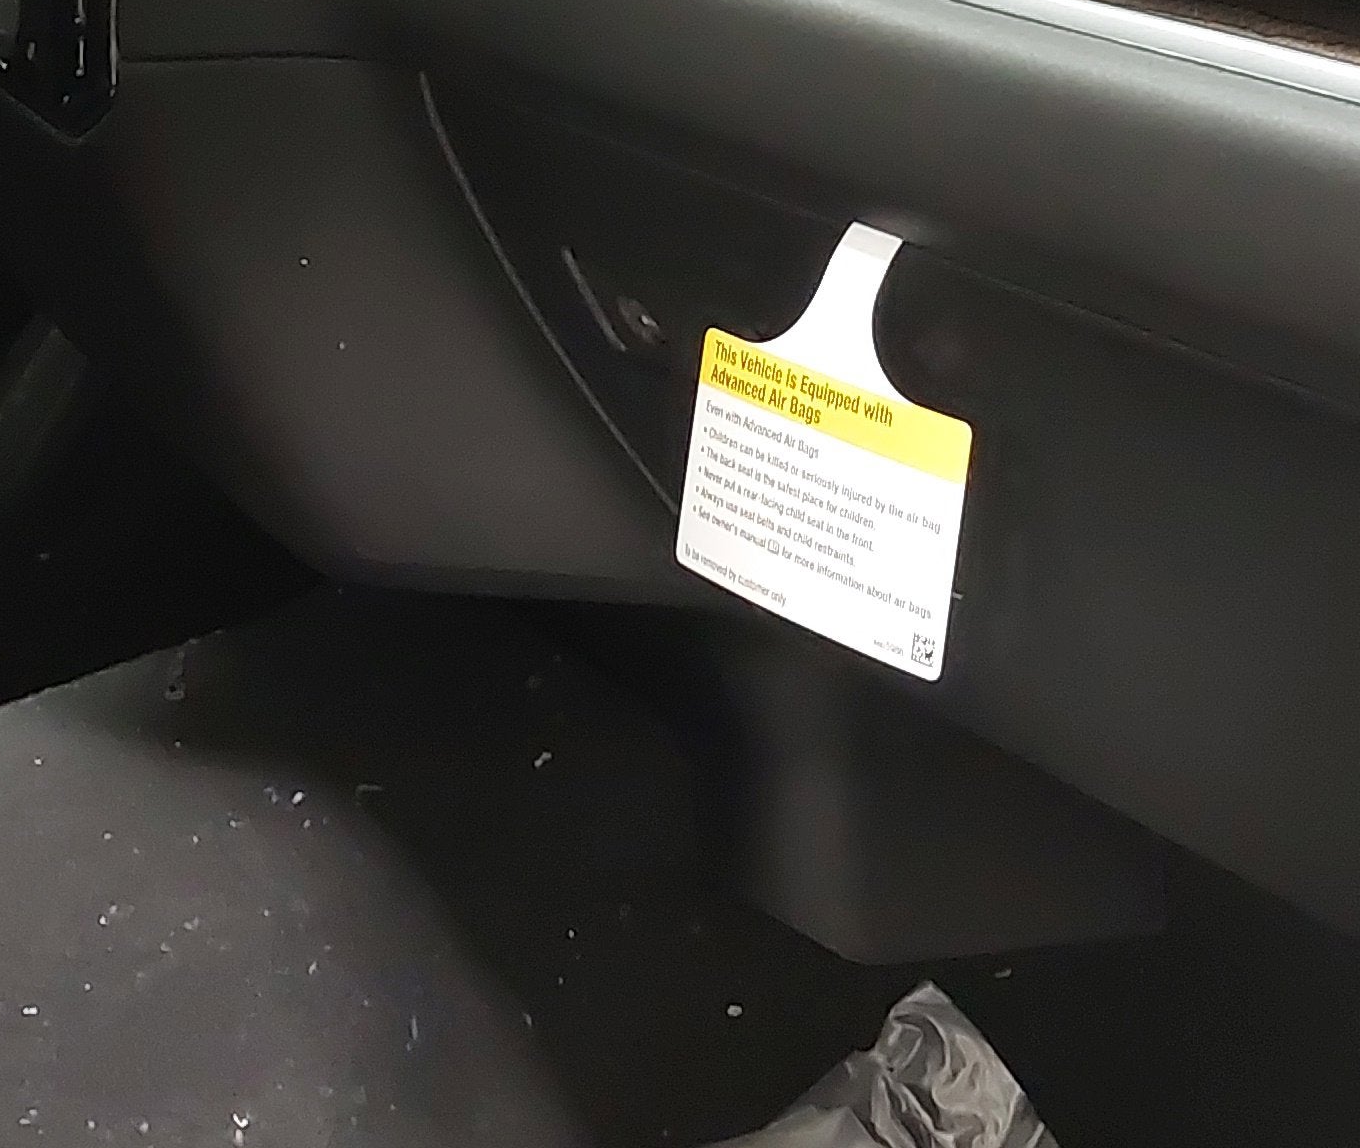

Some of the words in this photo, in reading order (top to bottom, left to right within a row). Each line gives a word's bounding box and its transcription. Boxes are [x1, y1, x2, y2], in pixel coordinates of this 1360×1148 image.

[710, 364, 767, 402] Advanced
[767, 388, 788, 411] Air
[789, 395, 821, 425] Bags
[715, 339, 737, 366] This
[740, 350, 783, 384] Vehicle
[785, 368, 797, 390] is
[800, 375, 860, 414] Equipped
[864, 402, 893, 427] with
[705, 399, 724, 419] Even
[725, 411, 742, 427] with
[742, 416, 783, 444] Advanced
[783, 433, 796, 449] Air
[797, 439, 819, 460] Bags
[700, 485, 724, 508] Always
[725, 501, 739, 515] use
[739, 507, 756, 523] seat
[756, 513, 775, 531] belts
[776, 524, 792, 539] and
[792, 532, 813, 548] child
[703, 465, 723, 485] Never
[723, 478, 736, 493] put
[736, 484, 742, 496] a
[785, 507, 806, 523] child
[806, 515, 825, 532] seat
[825, 522, 834, 535] in
[836, 526, 850, 541] the
[706, 445, 719, 463] The
[719, 453, 736, 469] back
[737, 463, 754, 479] seat
[754, 469, 762, 483] is
[763, 473, 776, 489] the
[777, 480, 801, 499] safest
[801, 491, 824, 509] place
[826, 499, 838, 515] for
[708, 426, 738, 449] Children
[739, 443, 754, 457] can
[755, 447, 765, 462] be
[767, 452, 789, 473] killed
[790, 465, 799, 476] or
[801, 469, 840, 495] seriously
[841, 484, 873, 507] injured
[874, 497, 886, 514] by
[888, 503, 904, 519] the
[906, 512, 919, 524] air
[922, 515, 941, 535] bag
[697, 505, 711, 522] See
[739, 528, 767, 548] manual
[781, 545, 793, 560] for
[794, 554, 815, 571] more
[816, 562, 864, 592] information
[866, 585, 892, 604] about
[893, 597, 906, 609] air
[908, 600, 932, 620] bags
